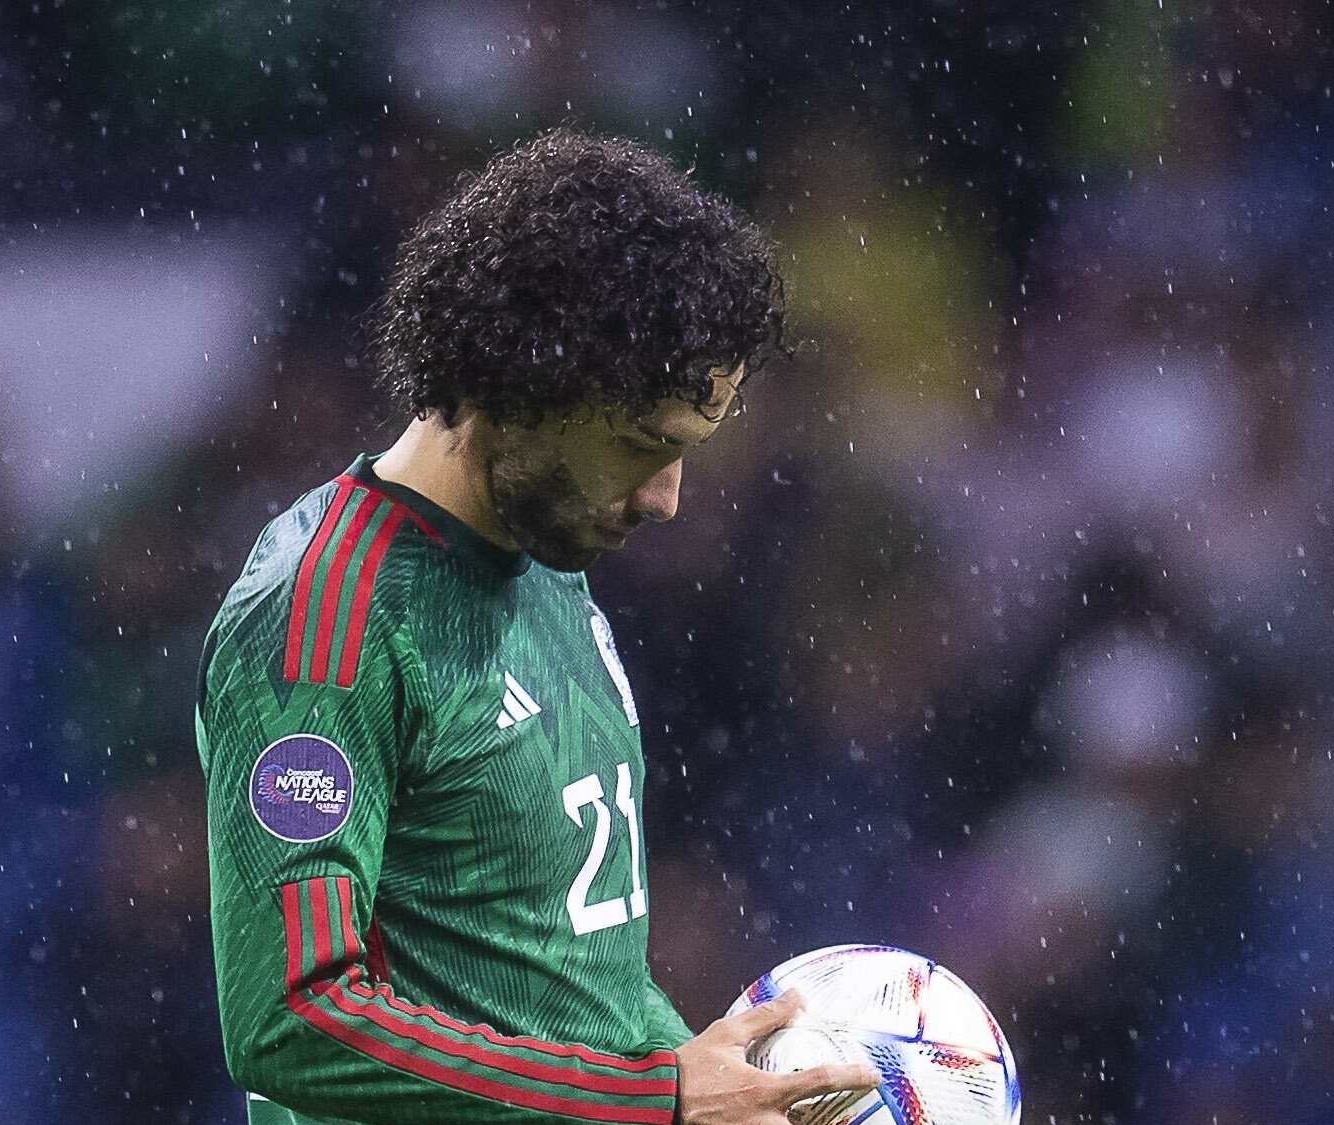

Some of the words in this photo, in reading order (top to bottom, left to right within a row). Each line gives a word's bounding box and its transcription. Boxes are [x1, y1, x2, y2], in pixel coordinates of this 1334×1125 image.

[275, 775, 335, 791] NATIONS
[293, 788, 348, 804] LEAGUE
[562, 762, 648, 936] 21
